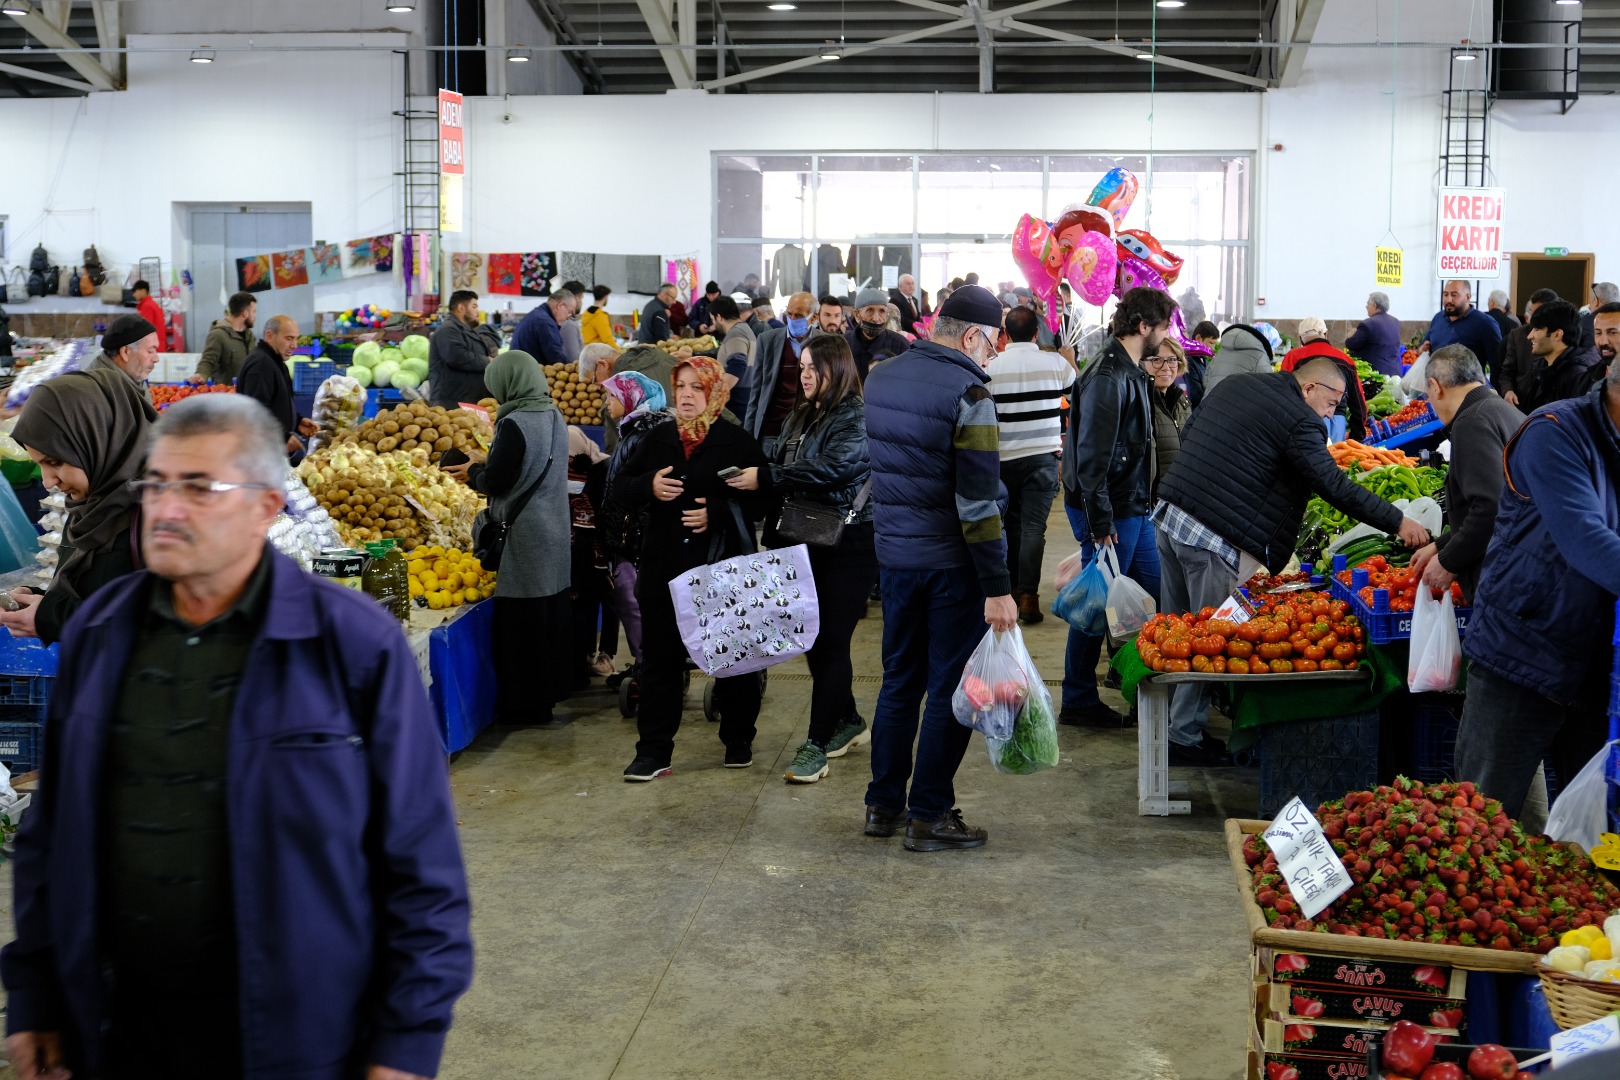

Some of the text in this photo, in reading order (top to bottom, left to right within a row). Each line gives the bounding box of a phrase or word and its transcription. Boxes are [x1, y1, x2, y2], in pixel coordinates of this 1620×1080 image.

[441, 100, 462, 128] ADEM
[443, 139, 463, 165] BABA
[1443, 195, 1502, 221] KREDİ
[1441, 225, 1500, 251] KARTI
[1377, 250, 1401, 264] KREDİ
[1441, 256, 1497, 273] GEÇERLİDİR
[1377, 263, 1401, 276] KARTI
[1334, 964, 1386, 986] ÇAVUŞ
[1352, 996, 1404, 1017] ÇAVUŞ
[1327, 1063, 1368, 1079] ÇAVU
